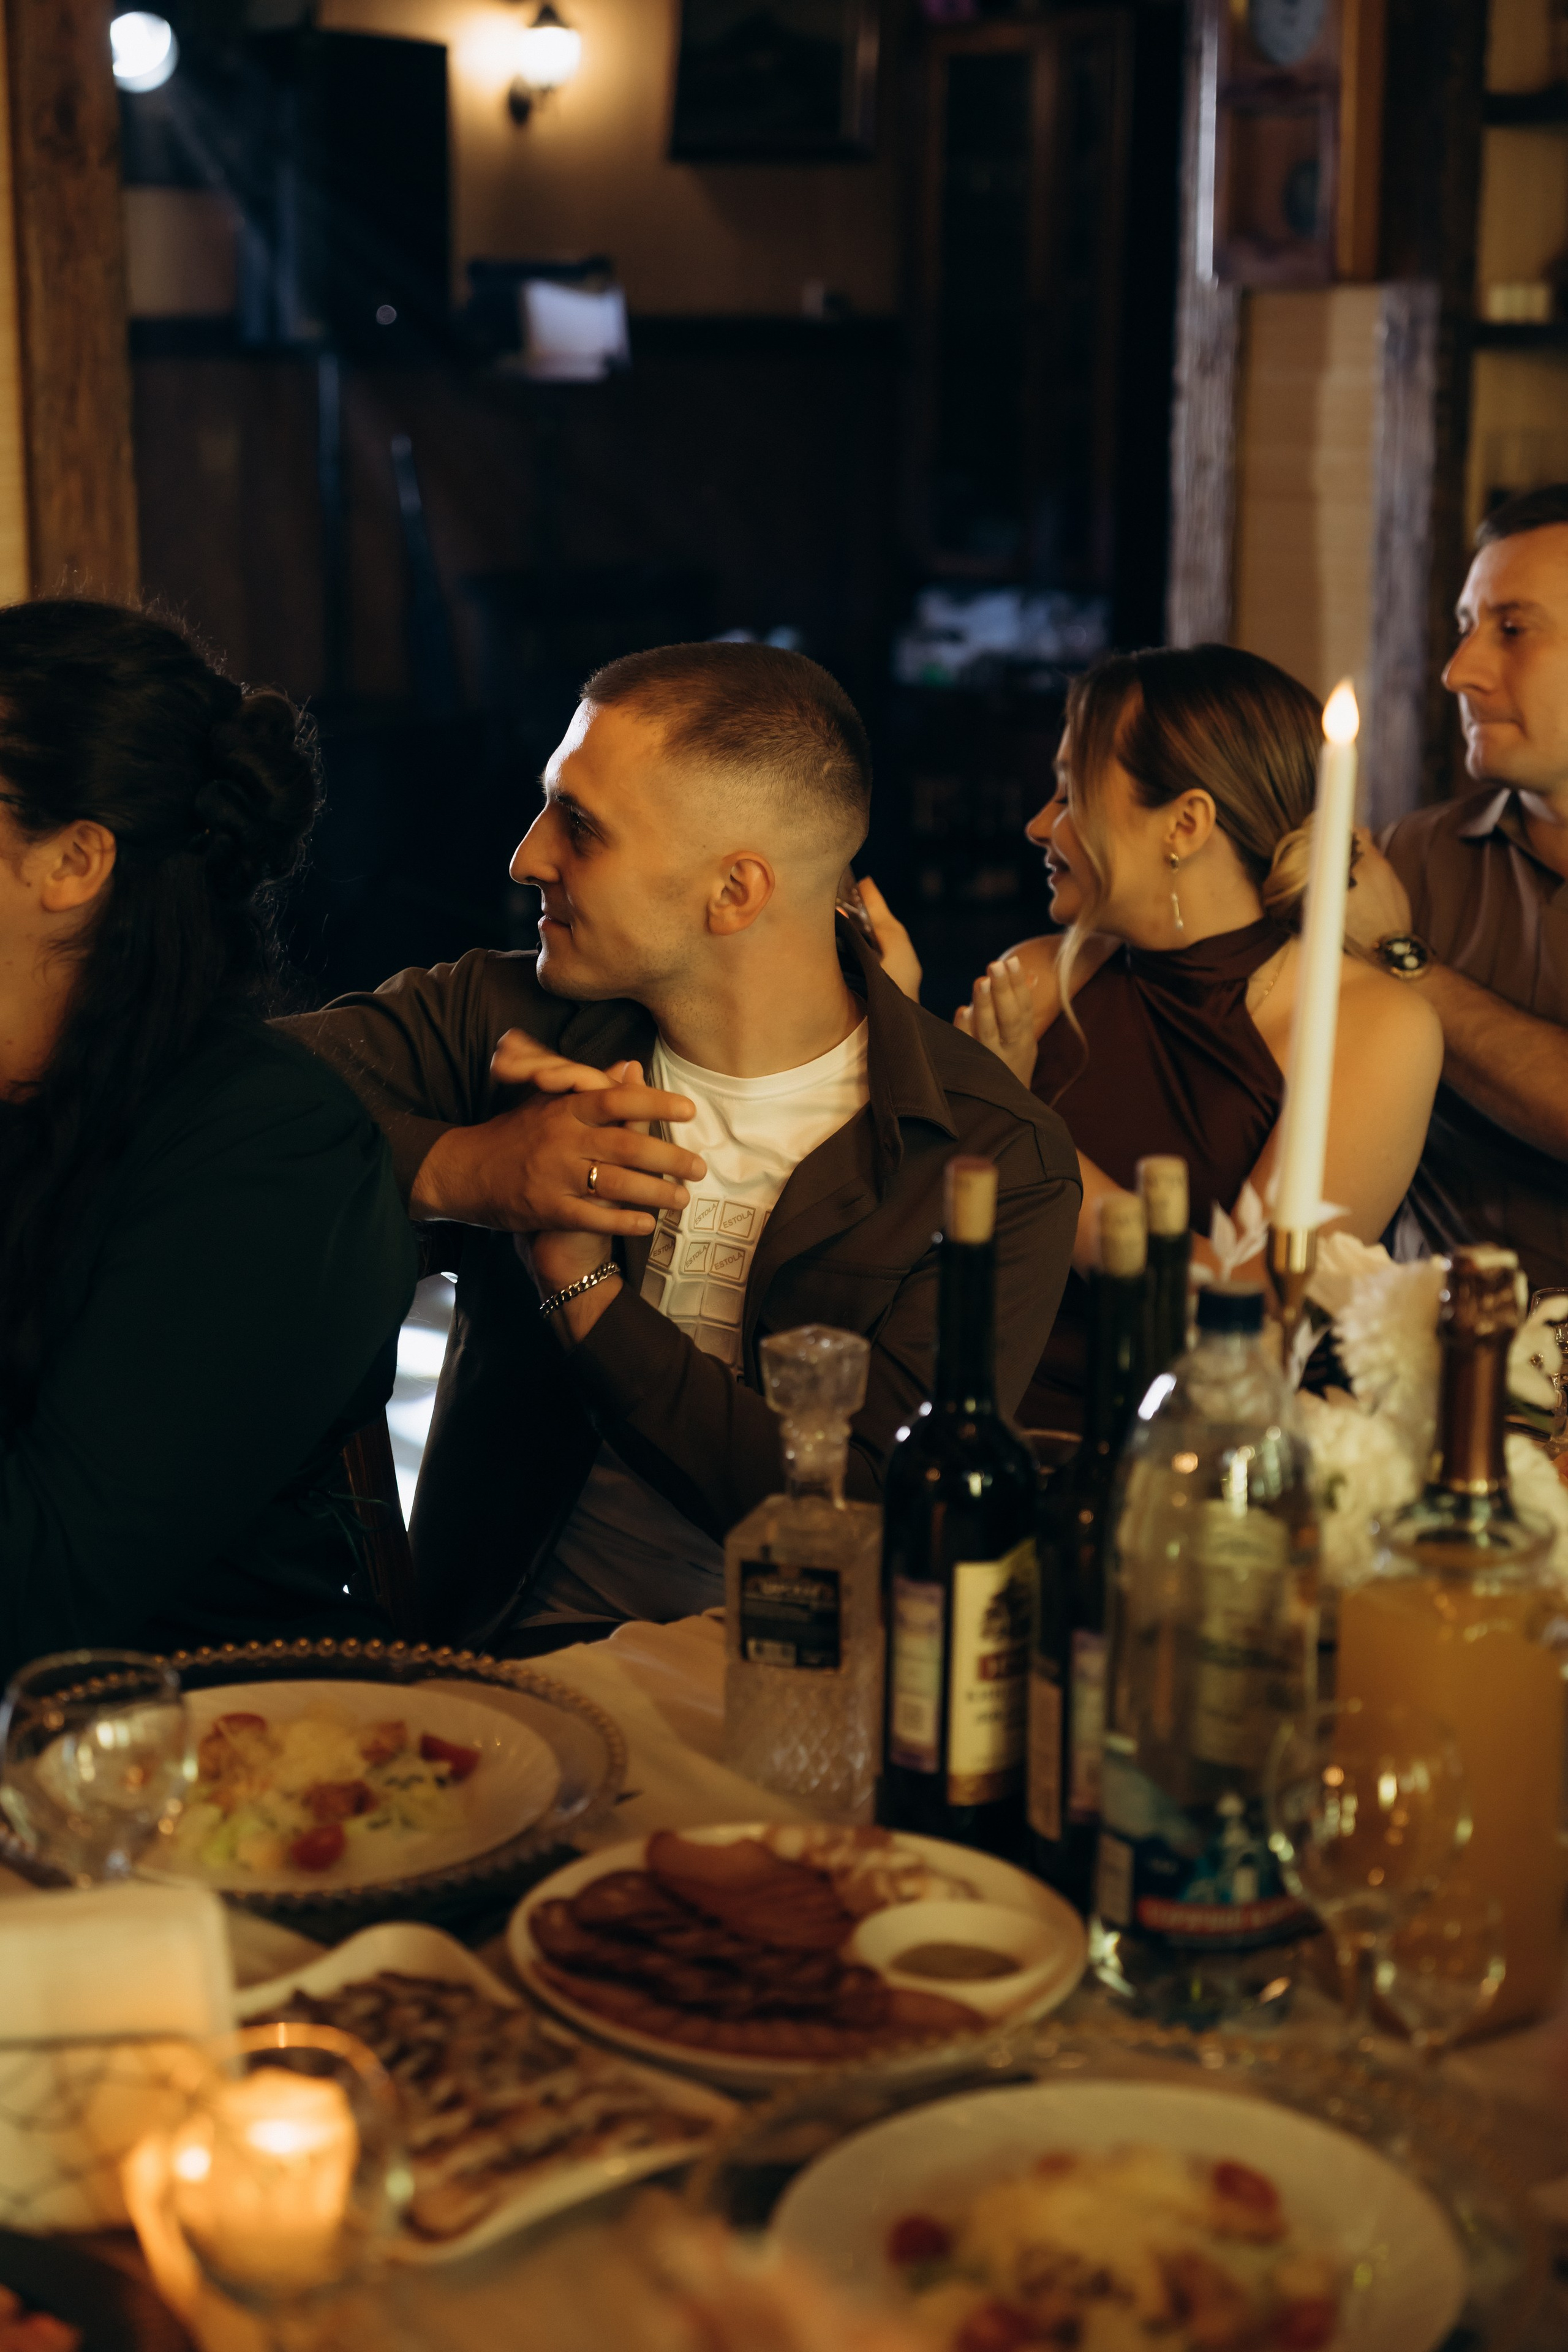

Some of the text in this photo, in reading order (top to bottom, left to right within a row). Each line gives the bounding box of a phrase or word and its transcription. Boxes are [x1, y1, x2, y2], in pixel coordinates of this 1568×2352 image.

[694, 1203, 717, 1225] ESTOLA
[723, 1210, 753, 1229] ESTOLA
[653, 1241, 673, 1257] ESTOL
[685, 1245, 707, 1268] ESTOLA
[714, 1252, 743, 1270] ESTOLA
